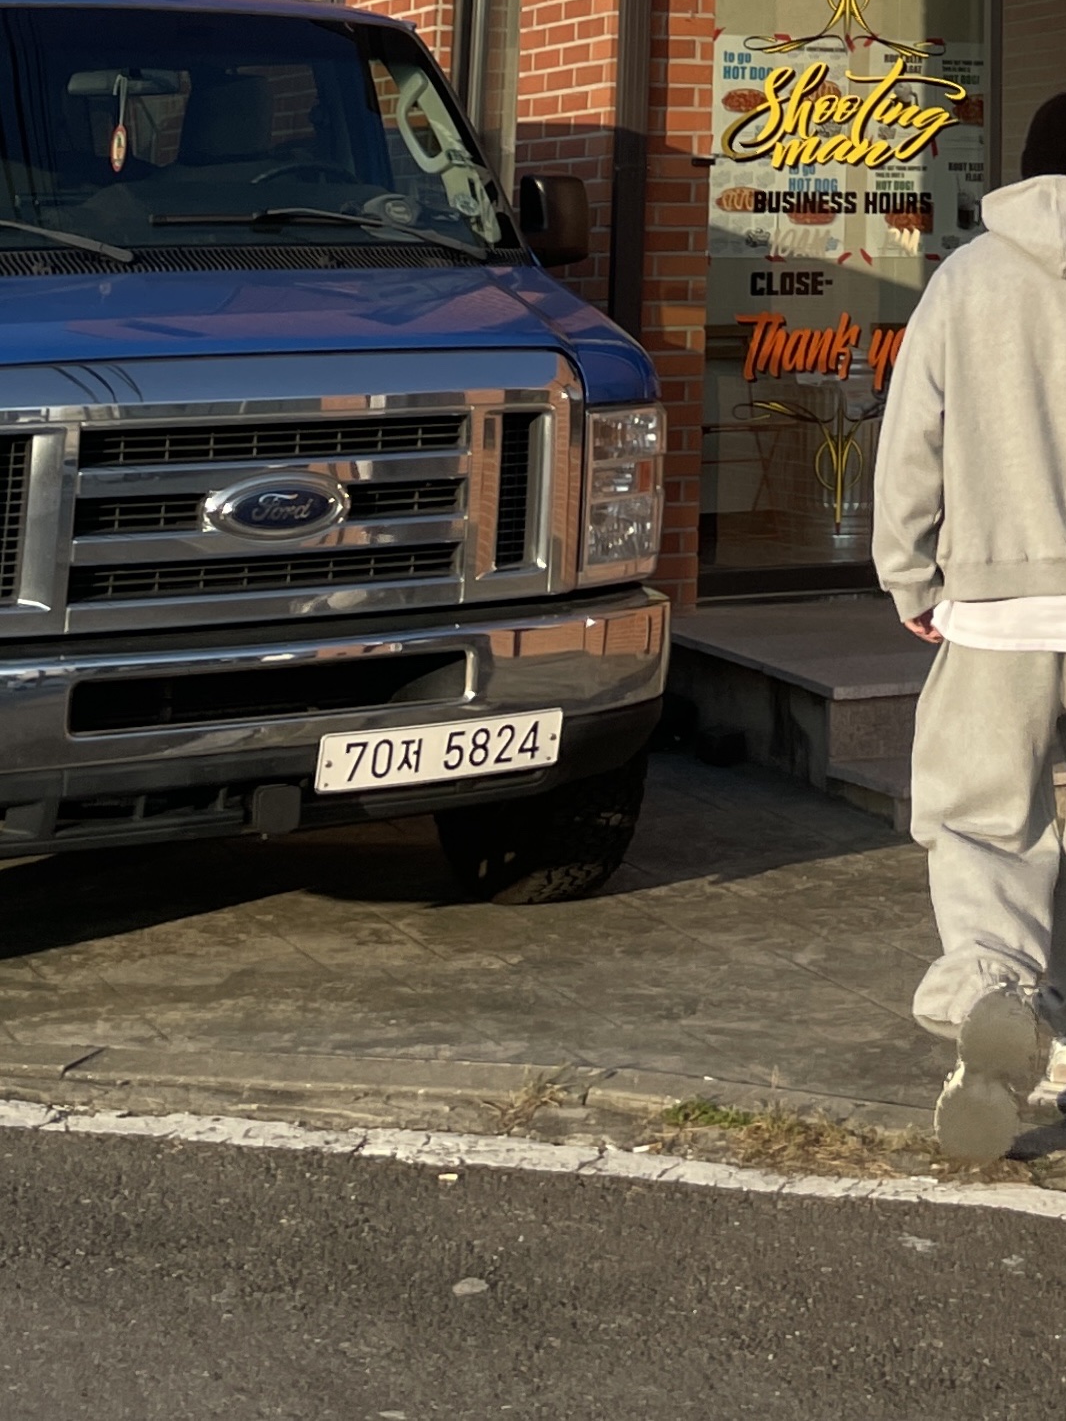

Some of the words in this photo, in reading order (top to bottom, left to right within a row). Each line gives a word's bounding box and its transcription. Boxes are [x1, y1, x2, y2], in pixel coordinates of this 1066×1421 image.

[724, 51, 735, 63] to
[737, 52, 752, 65] go
[723, 66, 748, 79] HOT
[721, 62, 966, 161] Shooting
[771, 133, 896, 169] man
[788, 178, 812, 192] HOT
[814, 178, 838, 192] DOG
[753, 191, 857, 214] BUSINESS
[864, 192, 932, 214] HOURS
[734, 311, 862, 383] Thank
[252, 493, 314, 520] Ford
[345, 737, 423, 782] 70저
[443, 721, 540, 770] 5824
